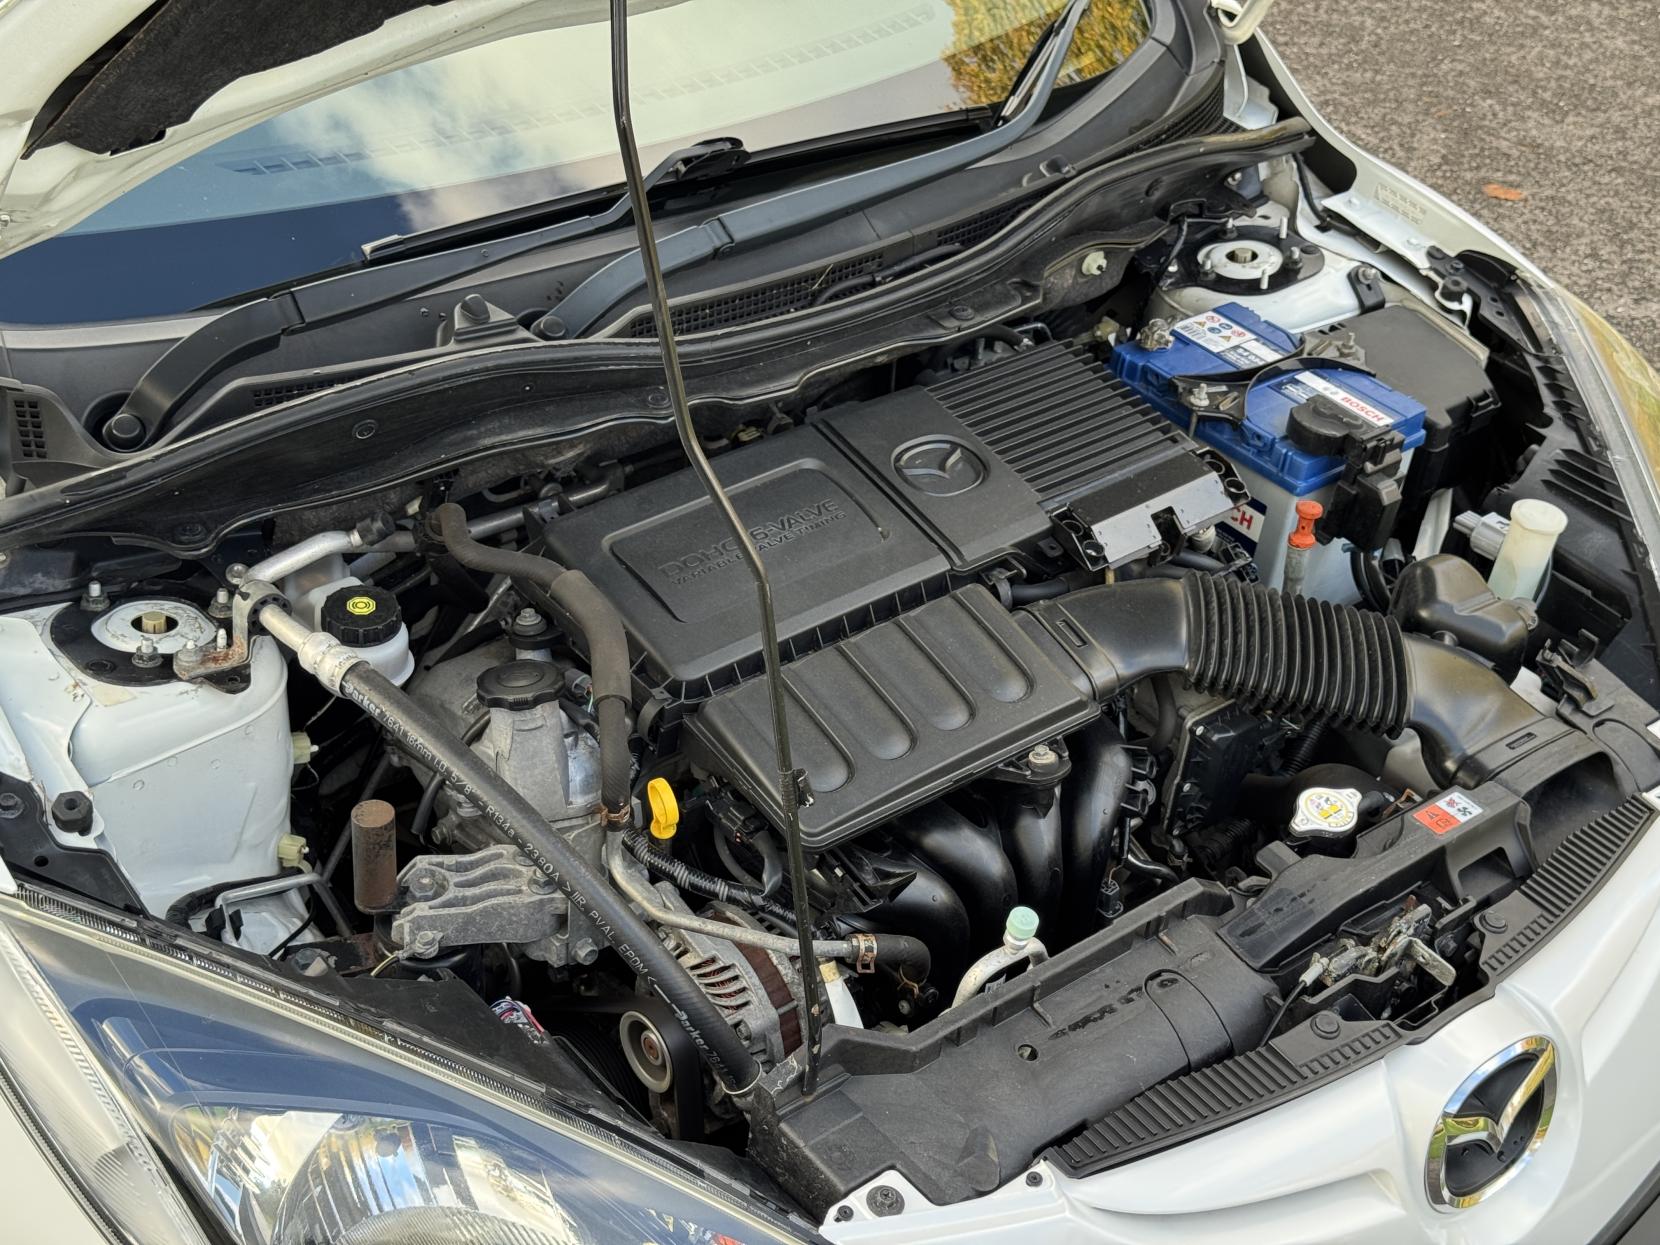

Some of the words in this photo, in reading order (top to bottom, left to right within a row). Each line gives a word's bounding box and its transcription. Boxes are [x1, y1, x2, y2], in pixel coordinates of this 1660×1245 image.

[1341, 396, 1384, 421] BOSCH
[658, 536, 739, 580] DOHC
[748, 498, 839, 541] 6-VALVE
[796, 510, 847, 535] TIMING
[341, 681, 381, 717] Parker
[486, 805, 515, 837] R134a
[525, 842, 560, 884] 2380A
